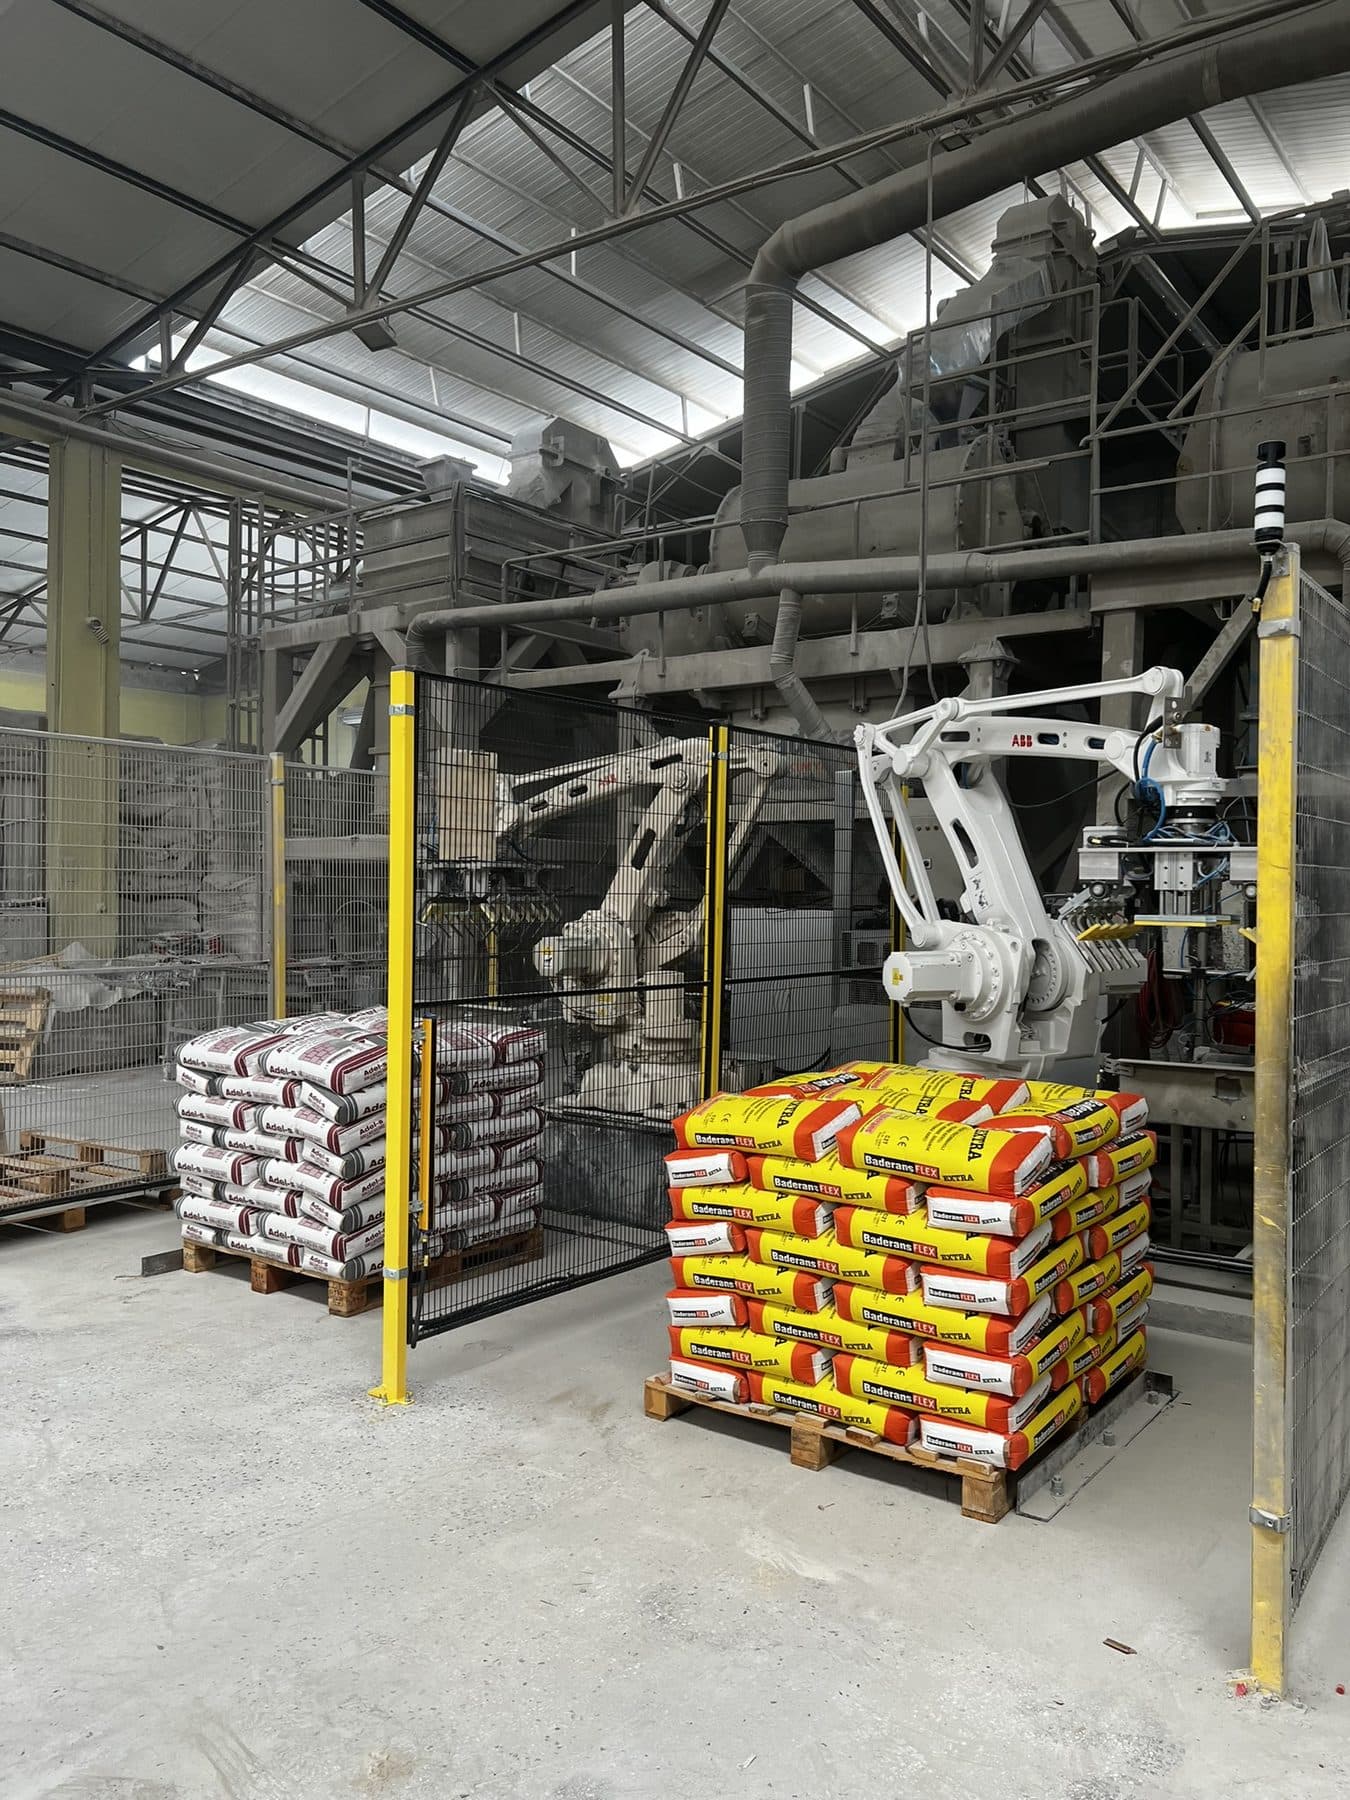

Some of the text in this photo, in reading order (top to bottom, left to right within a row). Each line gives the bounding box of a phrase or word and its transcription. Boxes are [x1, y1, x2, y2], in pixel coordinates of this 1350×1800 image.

[1011, 734, 1033, 747] ABB
[363, 1102, 386, 1114] Ade
[758, 1140, 782, 1149] EXTRA
[943, 1174, 974, 1182] EXTRA
[845, 1192, 872, 1200] EXTRA
[756, 1213, 781, 1222] EXTRA
[940, 1253, 972, 1261] EXTRA
[757, 1287, 782, 1296] EXTRA
[940, 1332, 971, 1341] EXTRA
[754, 1359, 779, 1367] EXTRA
[940, 1406, 971, 1415] EXTRA
[844, 1416, 872, 1425] EXTRA
